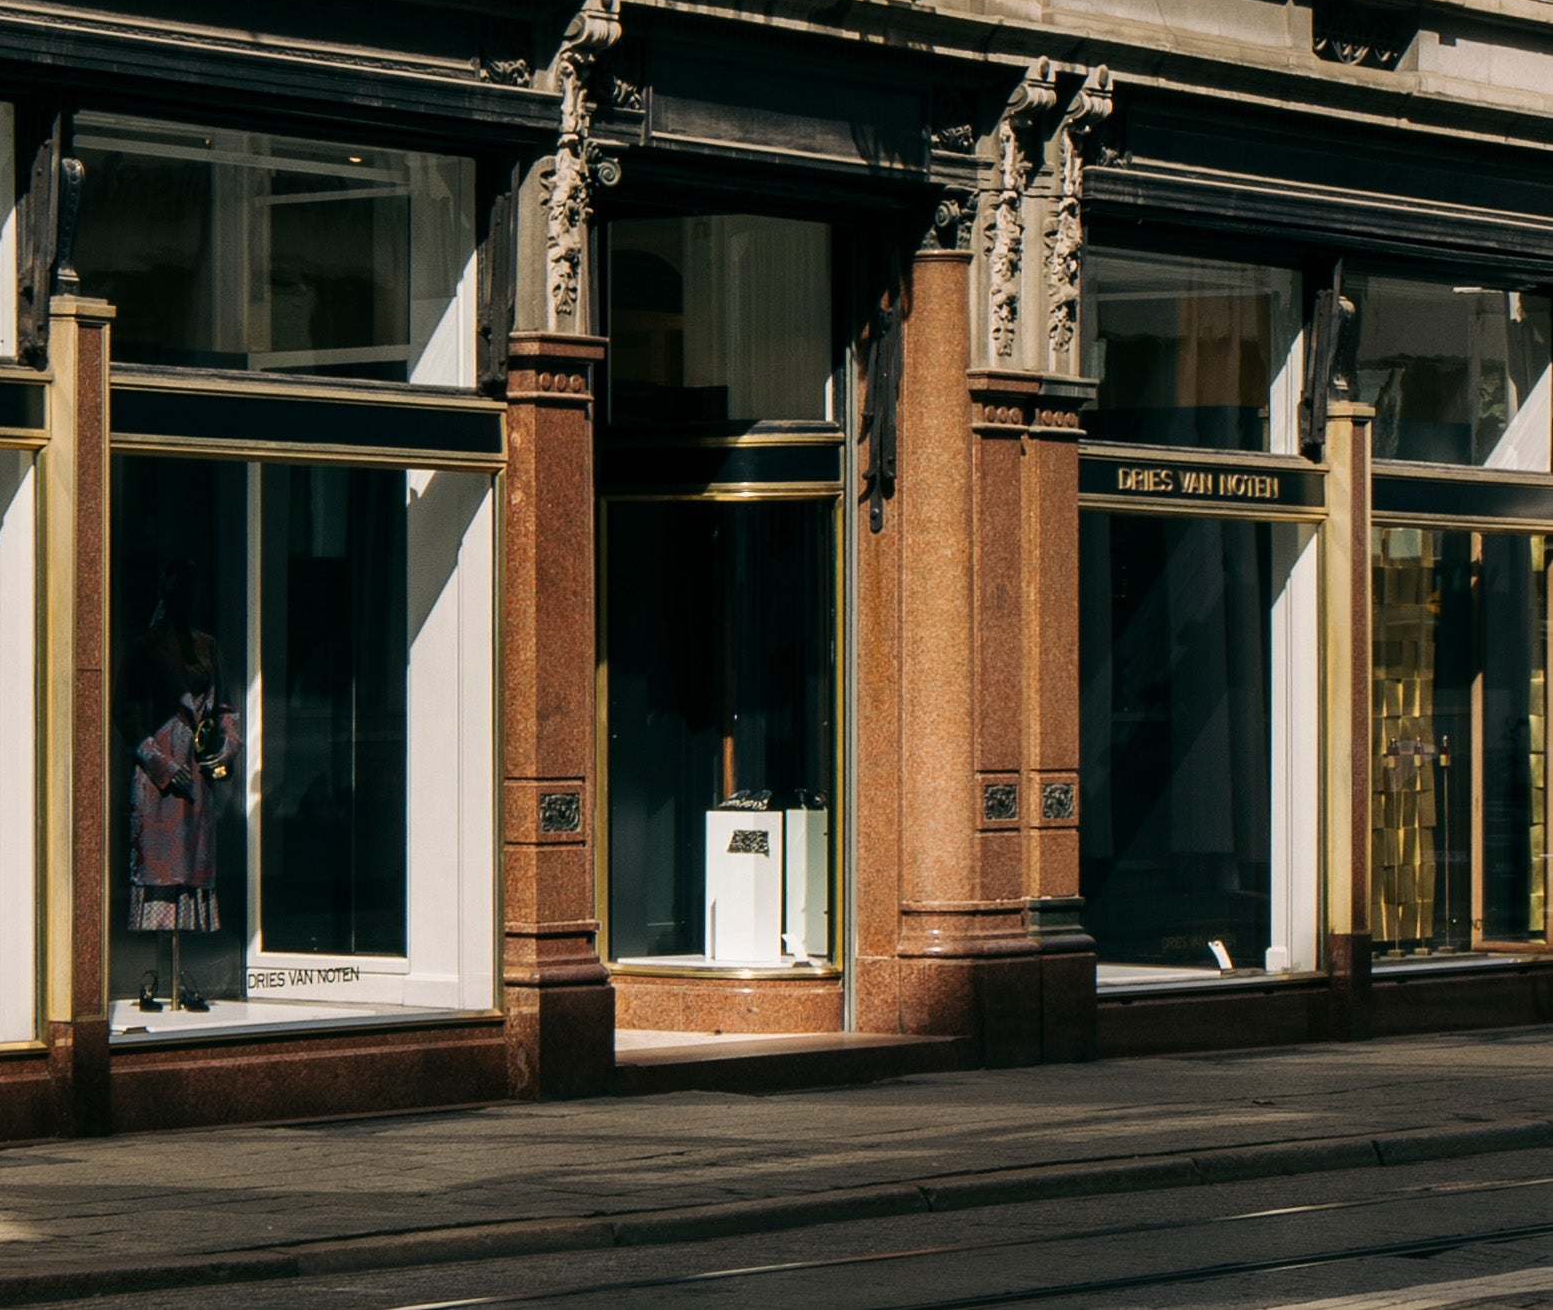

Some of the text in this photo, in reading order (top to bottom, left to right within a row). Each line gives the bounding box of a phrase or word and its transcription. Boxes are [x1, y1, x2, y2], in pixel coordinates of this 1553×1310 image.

[1117, 467, 1280, 499] DRIES VAN NOTEN
[248, 966, 360, 989] DRIES VAN NOTEN
